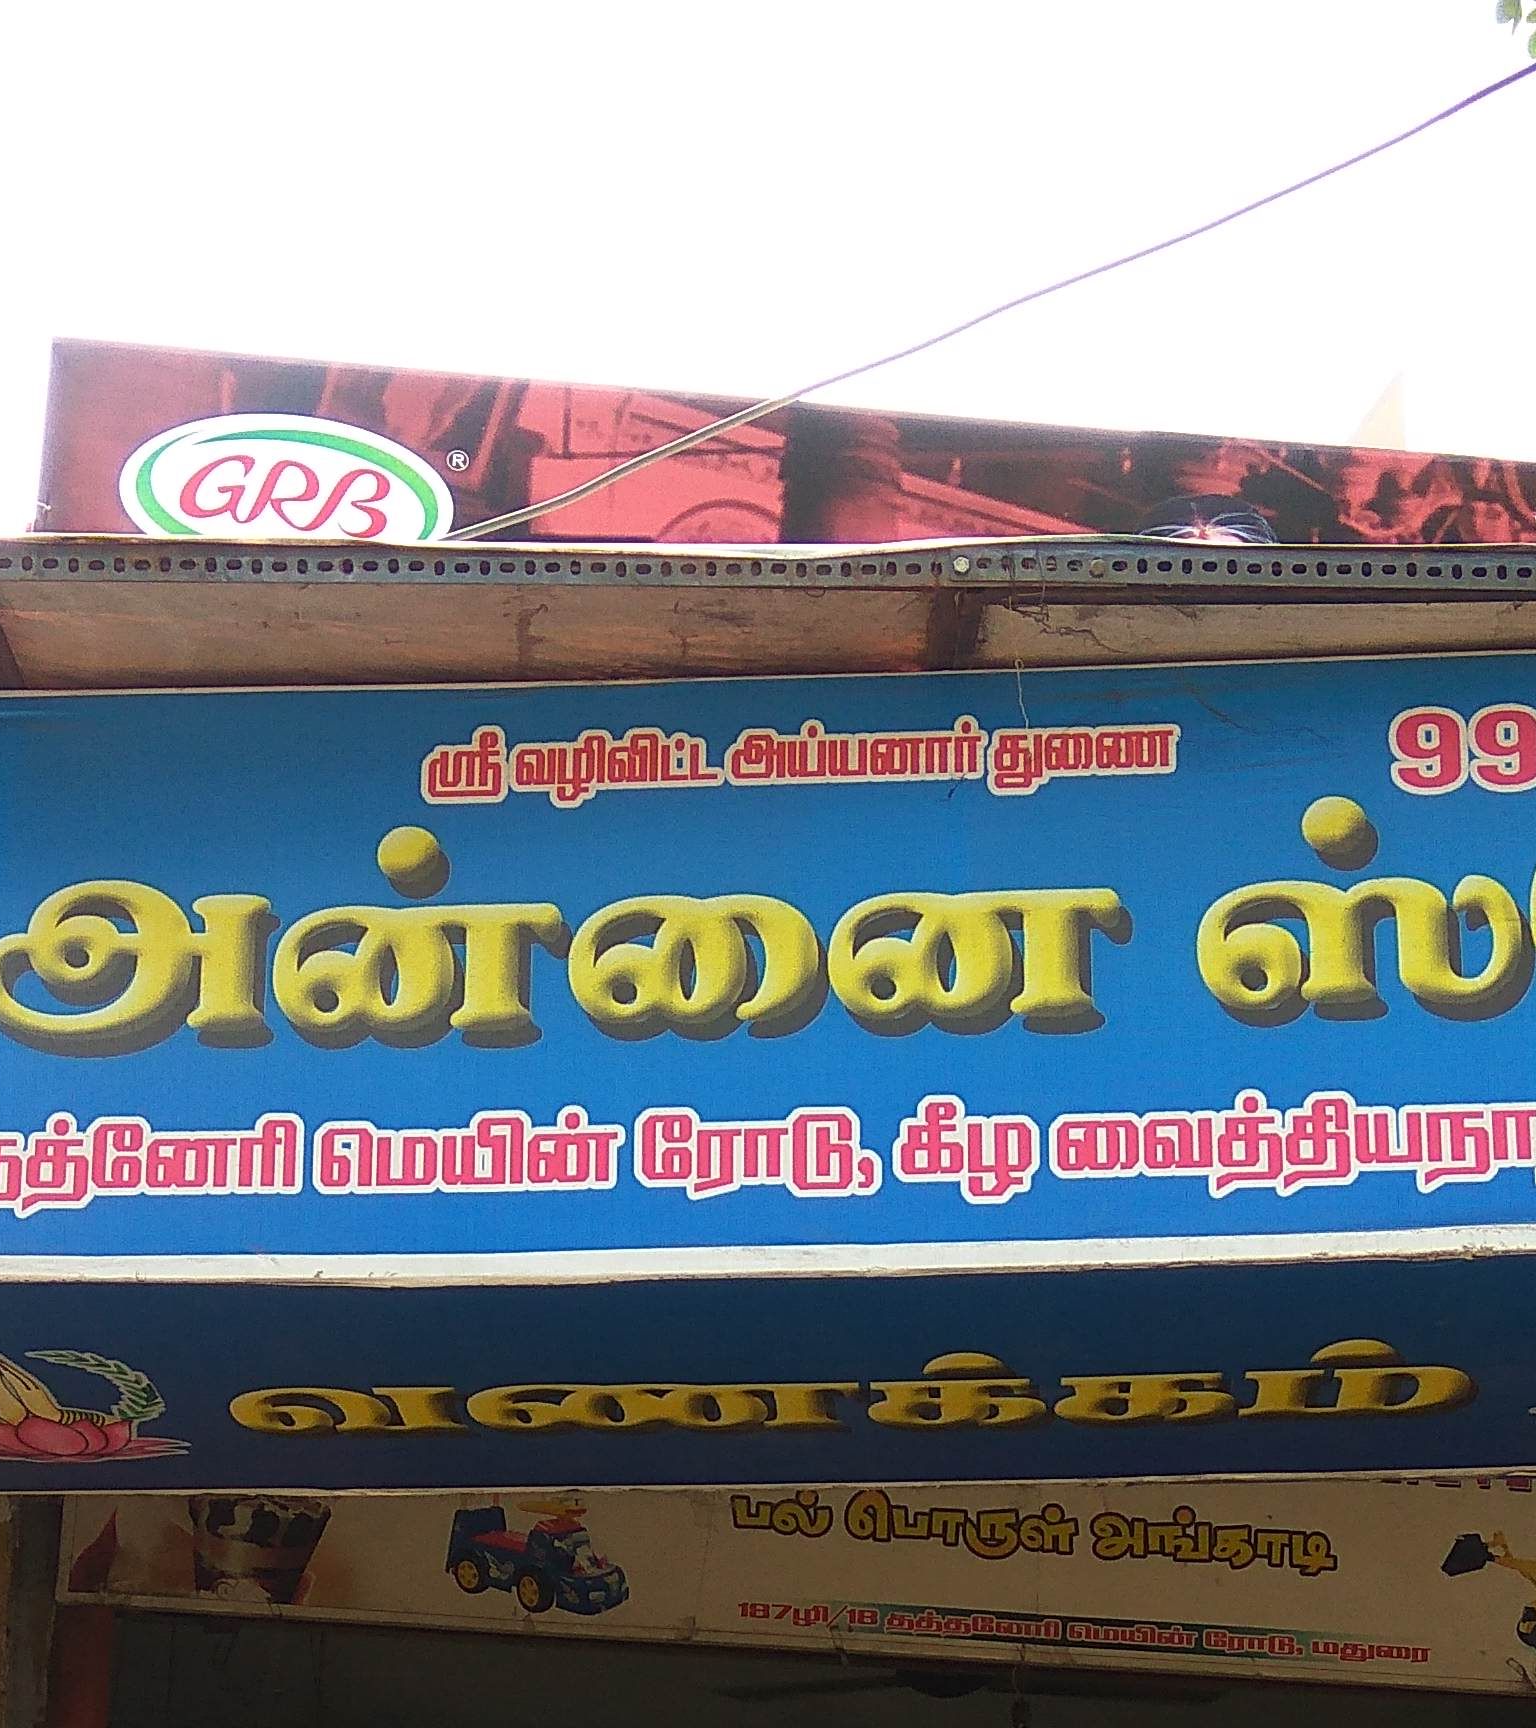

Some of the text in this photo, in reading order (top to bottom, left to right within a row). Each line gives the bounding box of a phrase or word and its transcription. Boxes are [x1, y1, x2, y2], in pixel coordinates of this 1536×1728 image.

[179, 455, 390, 538] GRB
[513, 729, 723, 804] வழிவிட்ட
[728, 719, 985, 782] அய்யனார்
[990, 726, 1178, 793] துணை
[314, 1107, 623, 1193] மெயின்
[636, 1107, 882, 1199] ரோடு,
[894, 1097, 1039, 1203] கீழ
[229, 1338, 1478, 1436] வணக்கம்
[731, 1489, 1339, 1577] பல் பொருள் அங்காடி
[1067, 1622, 1198, 1650] மெயின்
[1312, 1640, 1431, 1663] மதுரை
